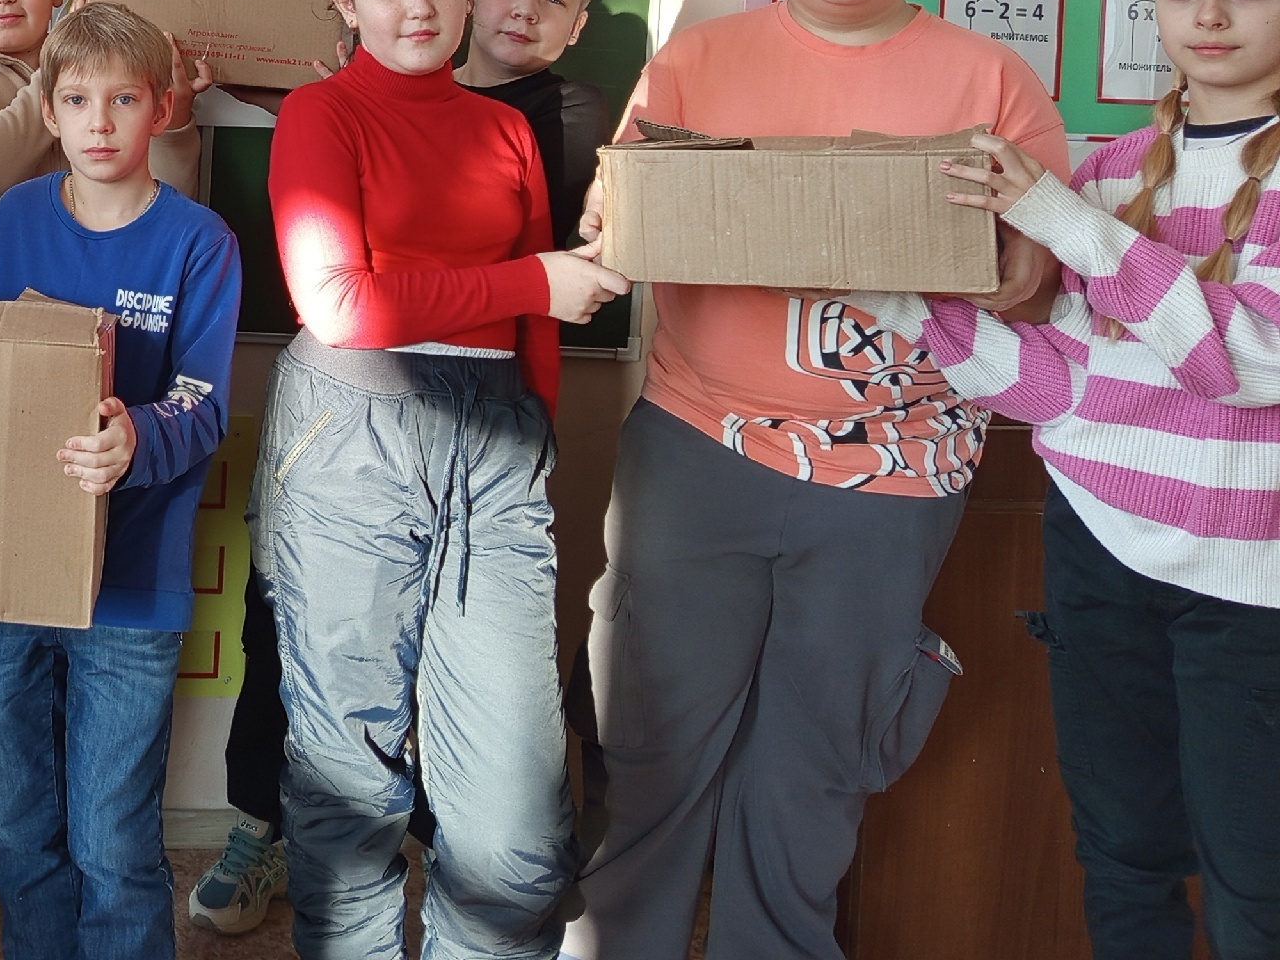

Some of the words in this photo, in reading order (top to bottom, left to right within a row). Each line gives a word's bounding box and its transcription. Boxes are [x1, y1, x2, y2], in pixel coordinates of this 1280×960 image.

[965, 1, 976, 18] 6
[999, 2, 1010, 20] 2
[1032, 3, 1044, 21] 4
[1128, 3, 1139, 21] 6
[991, 32, 1049, 43] ВЫЧИТАЕМОЕ
[1119, 62, 1172, 73] МНОЖИТЕЛЬ
